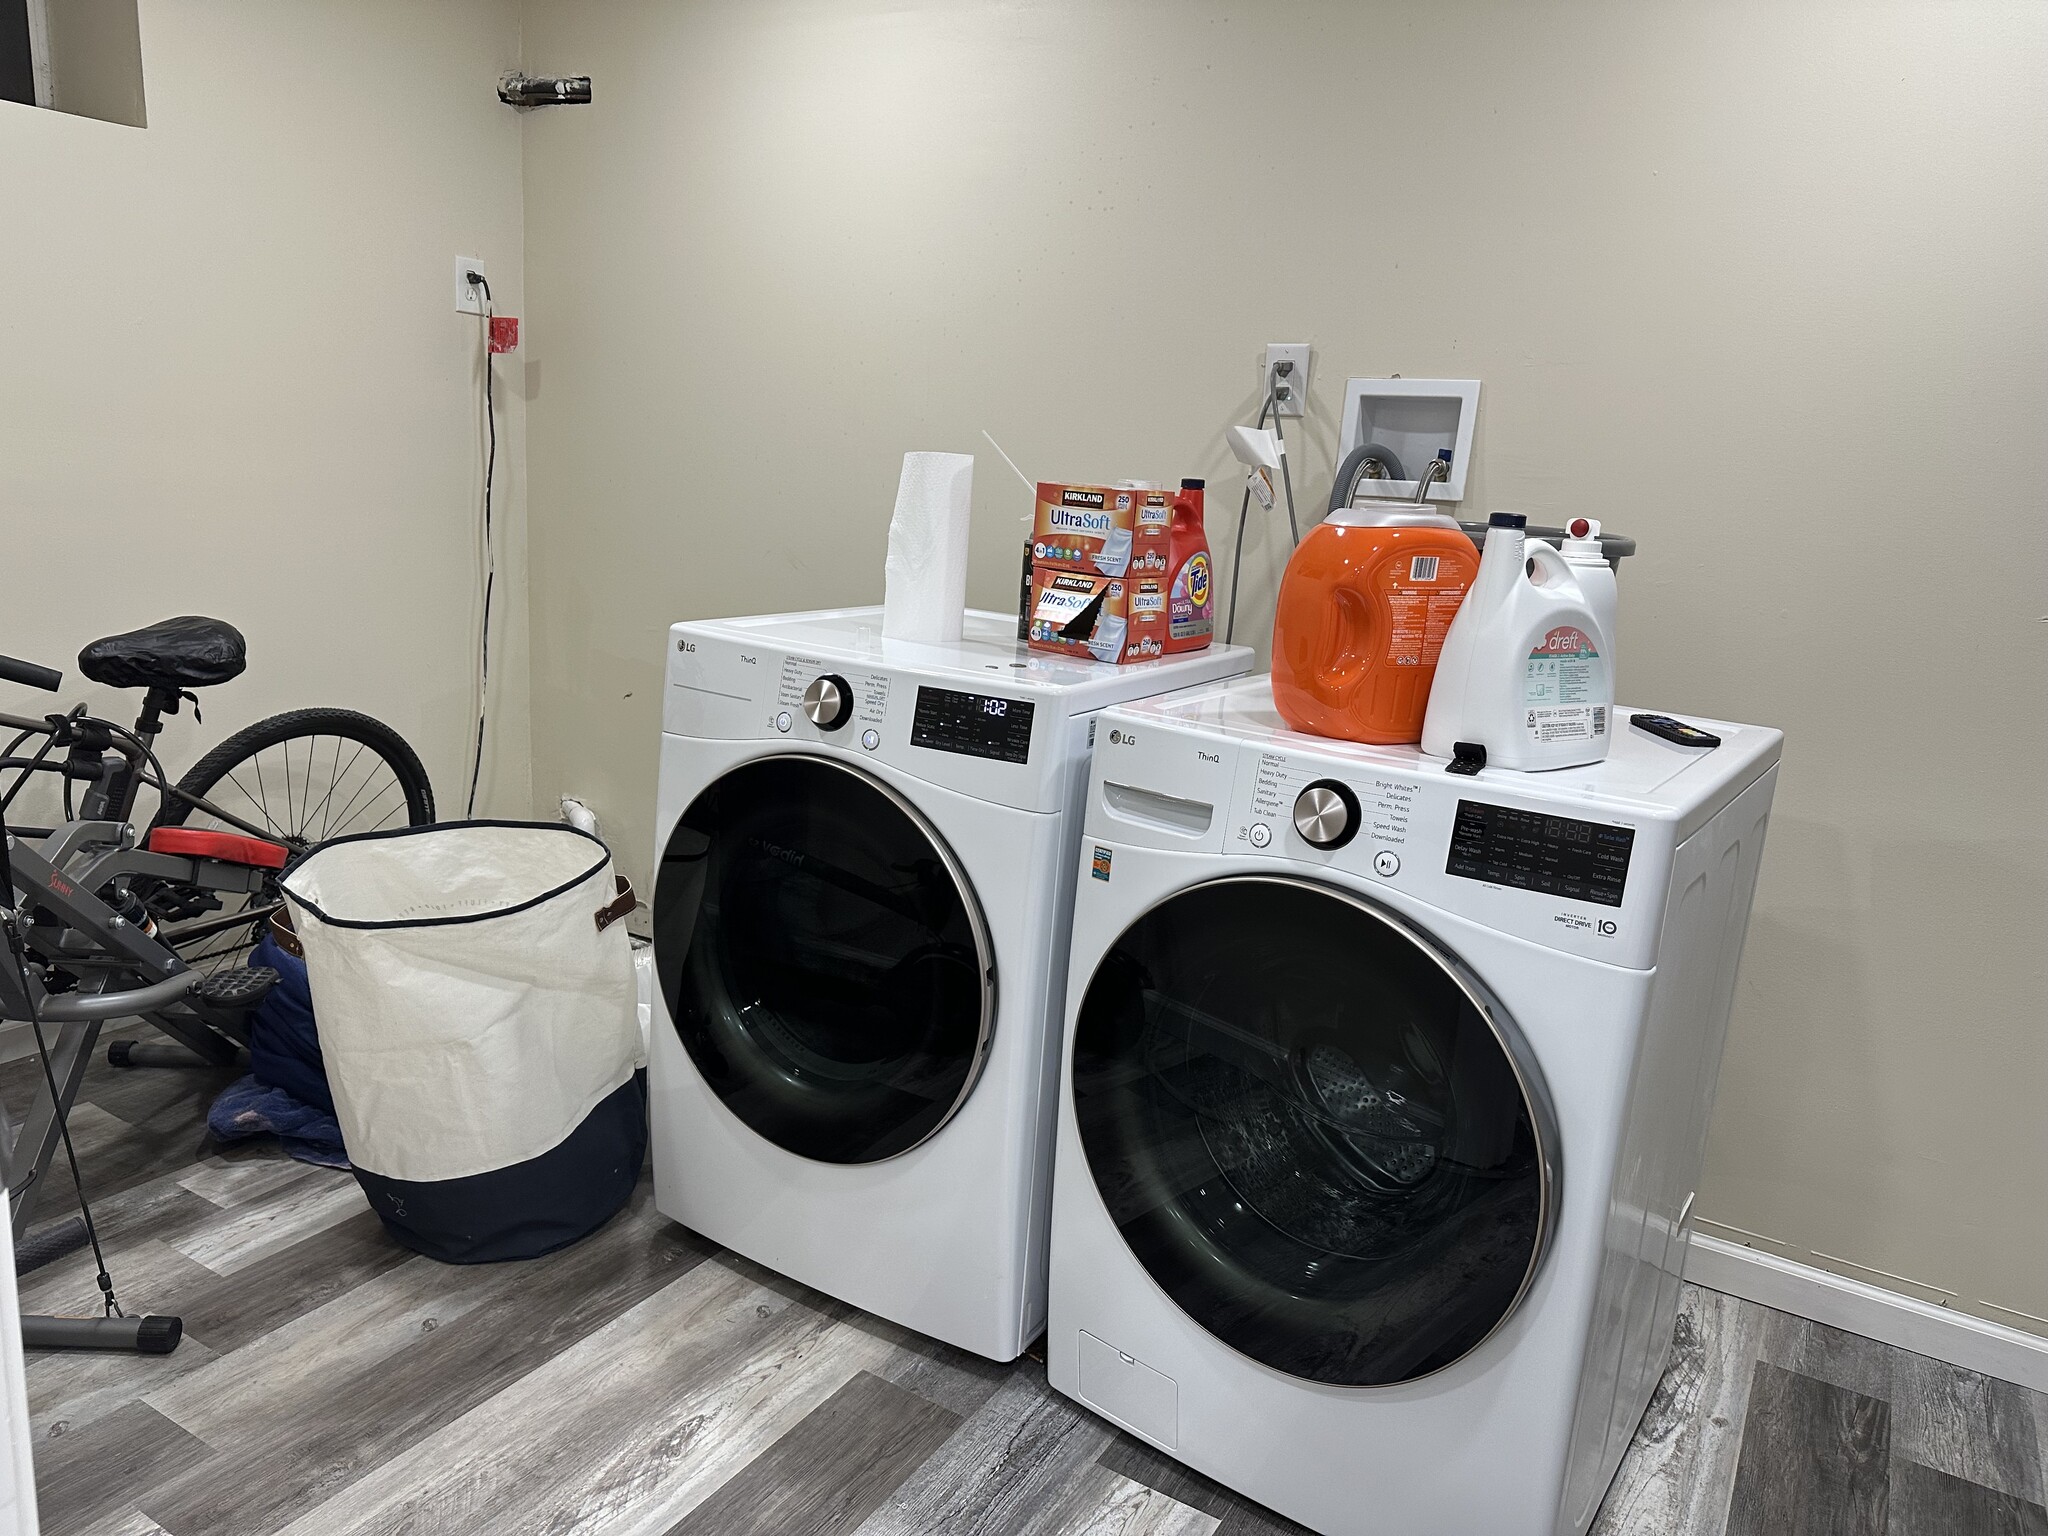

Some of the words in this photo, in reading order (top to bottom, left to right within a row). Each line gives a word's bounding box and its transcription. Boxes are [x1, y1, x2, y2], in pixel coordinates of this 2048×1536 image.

[1064, 492, 1103, 503] KIRKLAND
[1118, 496, 1129, 504] 250
[1051, 510, 1111, 530] UltraSoft
[1056, 578, 1093, 589] KIRKLAND
[1111, 584, 1122, 592] 250
[1191, 568, 1208, 598] Tide
[1135, 597, 1162, 606] UltraSoft
[1172, 604, 1192, 615] Downy
[1549, 631, 1578, 650] dreft
[686, 643, 696, 653] LG
[740, 655, 756, 665] ThinQ
[871, 674, 888, 682] Delicates
[984, 700, 1007, 716] 1:02
[860, 715, 883, 723] Downloaded
[1122, 734, 1135, 745] LG
[1198, 751, 1219, 763] ThinQ
[1262, 760, 1279, 768] Normal
[1260, 769, 1275, 777] Heavy
[1276, 771, 1288, 780] Duty
[1259, 778, 1278, 788] Bedding
[1376, 781, 1392, 789] Bright
[1257, 788, 1277, 798] Sanitary
[1387, 792, 1412, 802] Delicates
[1378, 801, 1392, 809] Perm.
[1395, 804, 1410, 812] Press
[1390, 814, 1408, 823] Towels
[1373, 822, 1390, 830] Speed
[1392, 825, 1407, 833] Wash
[1460, 825, 1483, 834] Pre-wash
[1371, 832, 1405, 844] Downloaded
[1455, 844, 1468, 852] Delay
[1610, 855, 1624, 863] Wash
[1607, 875, 1621, 883] Rinse
[1554, 916, 1574, 924] DIRECT
[1575, 920, 1592, 928] DRIVE
[1598, 920, 1617, 935] 10
